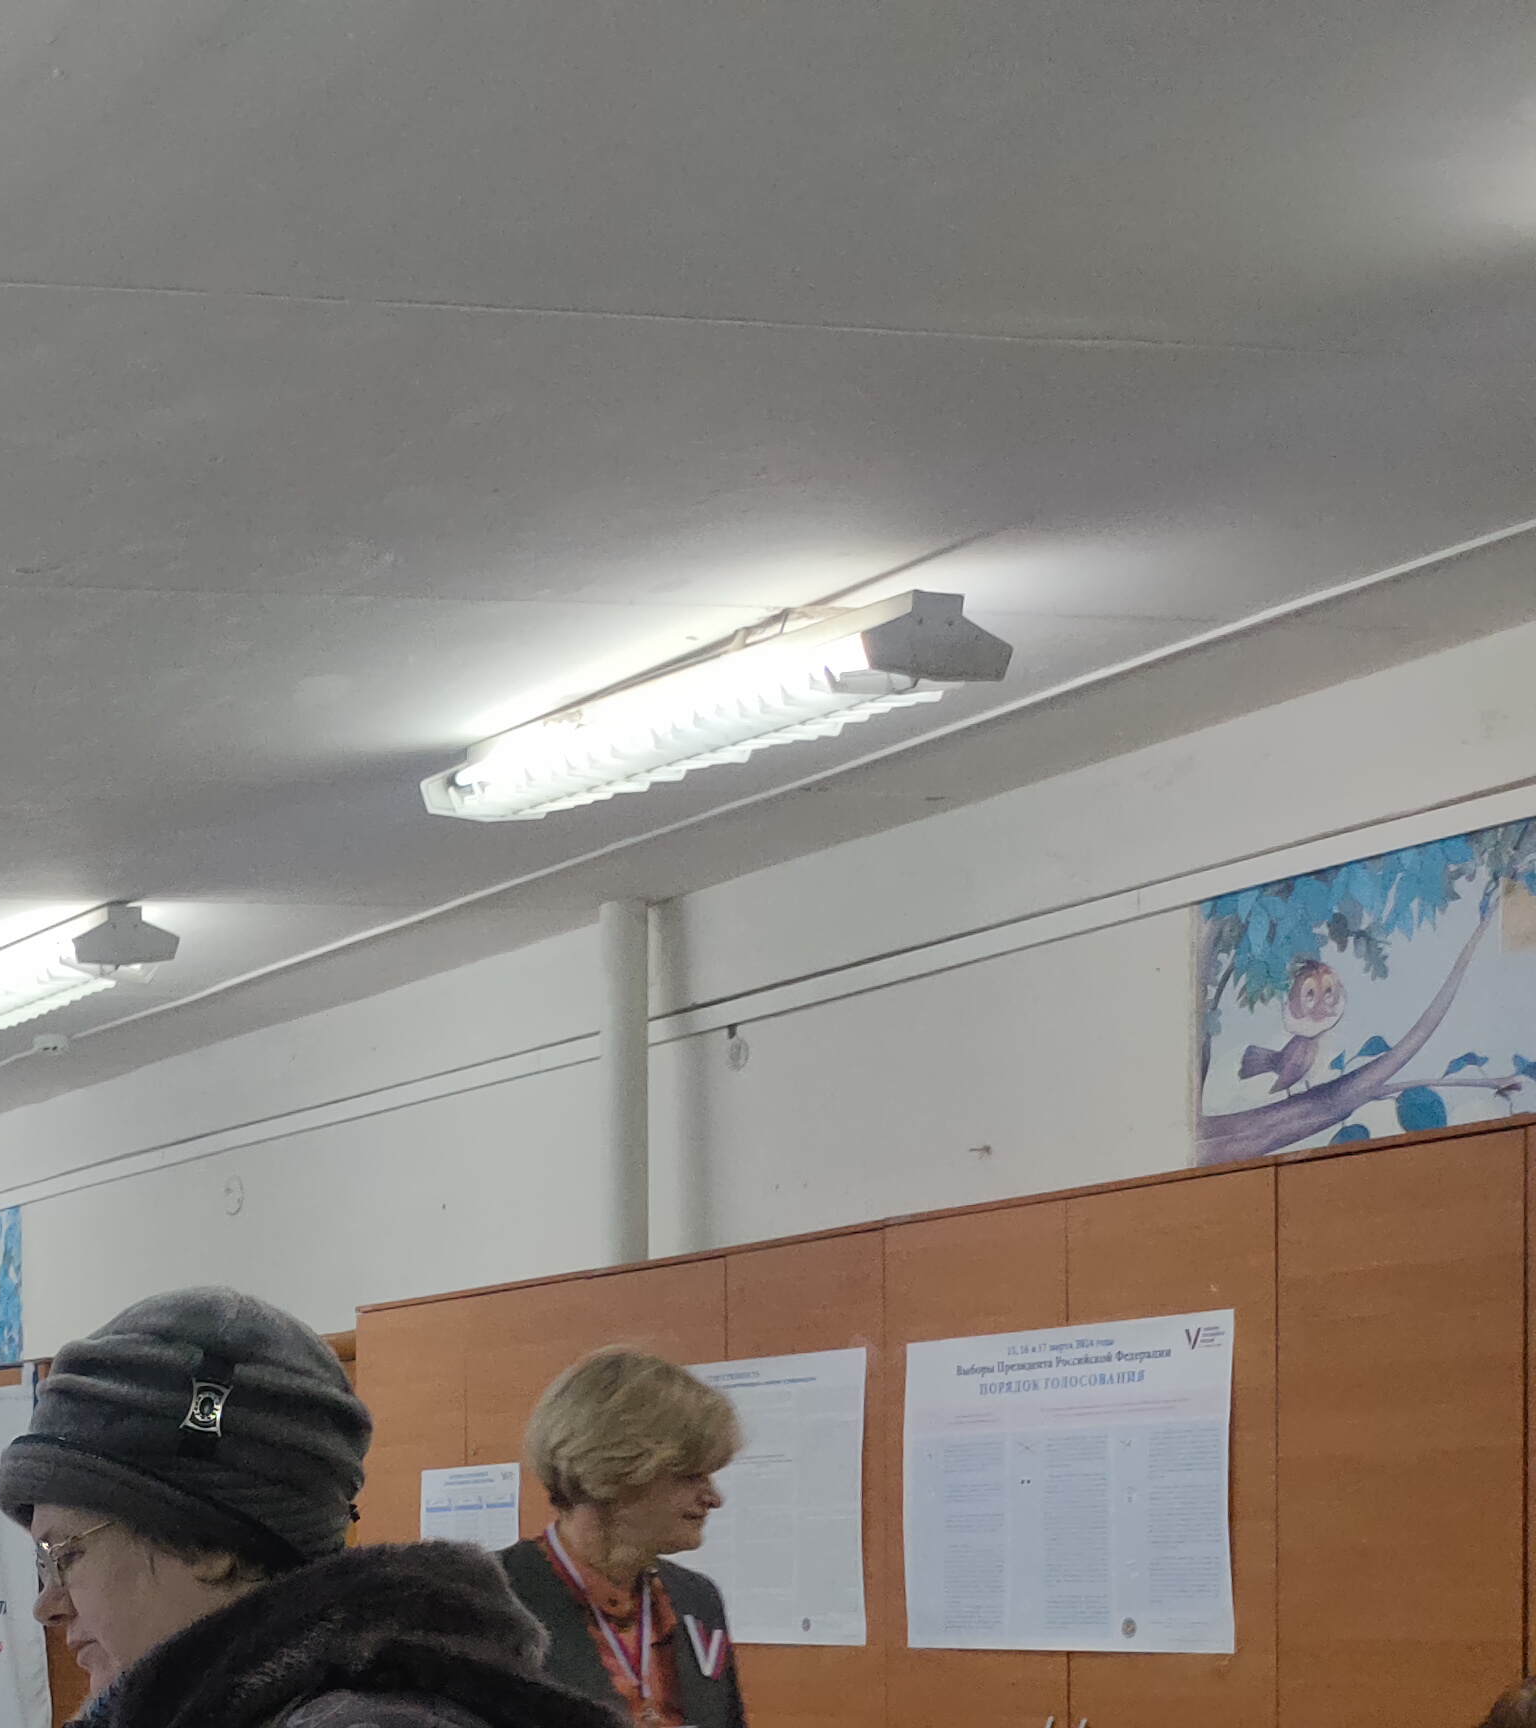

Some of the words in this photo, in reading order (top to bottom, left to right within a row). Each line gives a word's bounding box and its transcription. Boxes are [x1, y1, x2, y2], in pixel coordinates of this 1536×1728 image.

[956, 1363, 995, 1378] Выборы
[997, 1360, 1054, 1376] Президента
[1055, 1351, 1113, 1368] Российской
[1115, 1348, 1172, 1364] Федерации
[979, 1379, 1040, 1396] ПОРЯДОК
[1044, 1369, 1146, 1391] ГОЛОСОВАНИЯ
